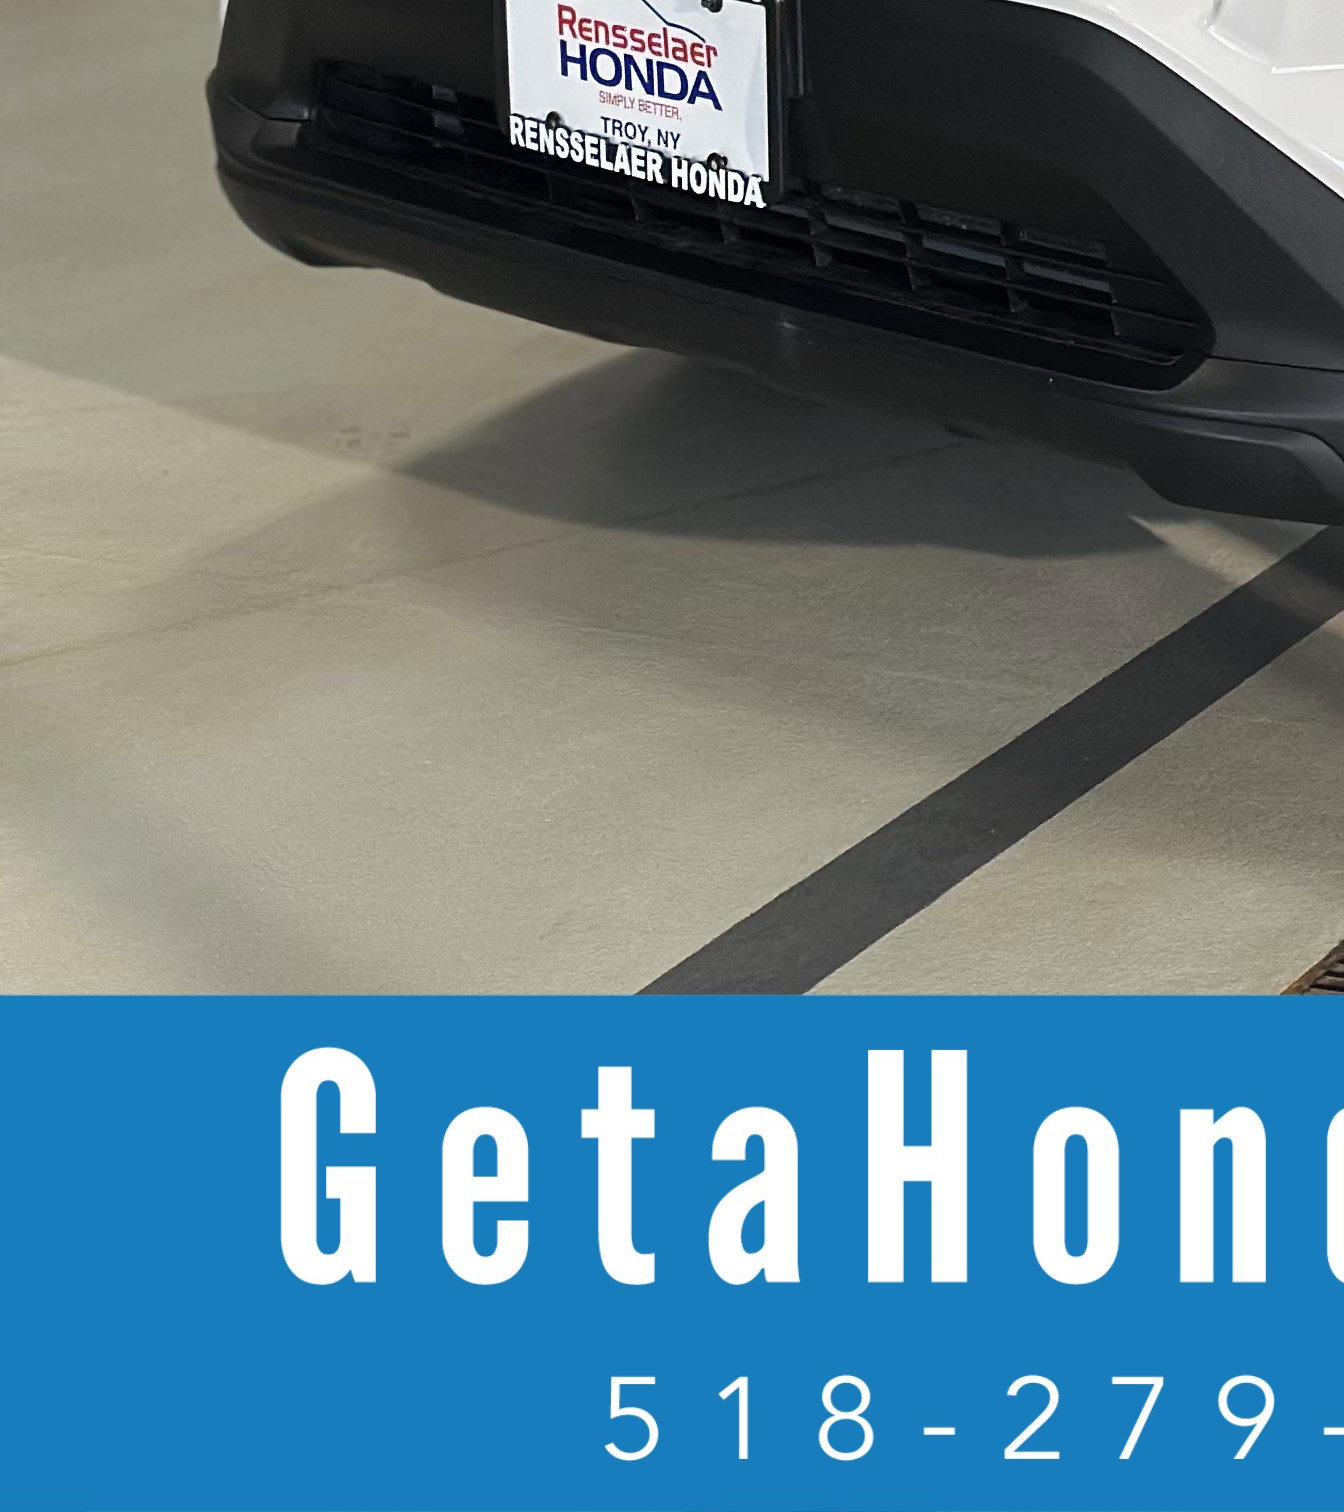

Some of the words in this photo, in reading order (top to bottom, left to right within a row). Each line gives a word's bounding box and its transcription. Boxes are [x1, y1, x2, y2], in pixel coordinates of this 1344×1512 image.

[556, 4, 719, 69] Rensselaer
[559, 40, 724, 112] HONDA
[598, 90, 636, 110] SIMPLY
[509, 115, 665, 185] RENSSELAER
[670, 155, 767, 209] HONDA
[600, 116, 652, 148] TROY,
[657, 128, 681, 150] NY
